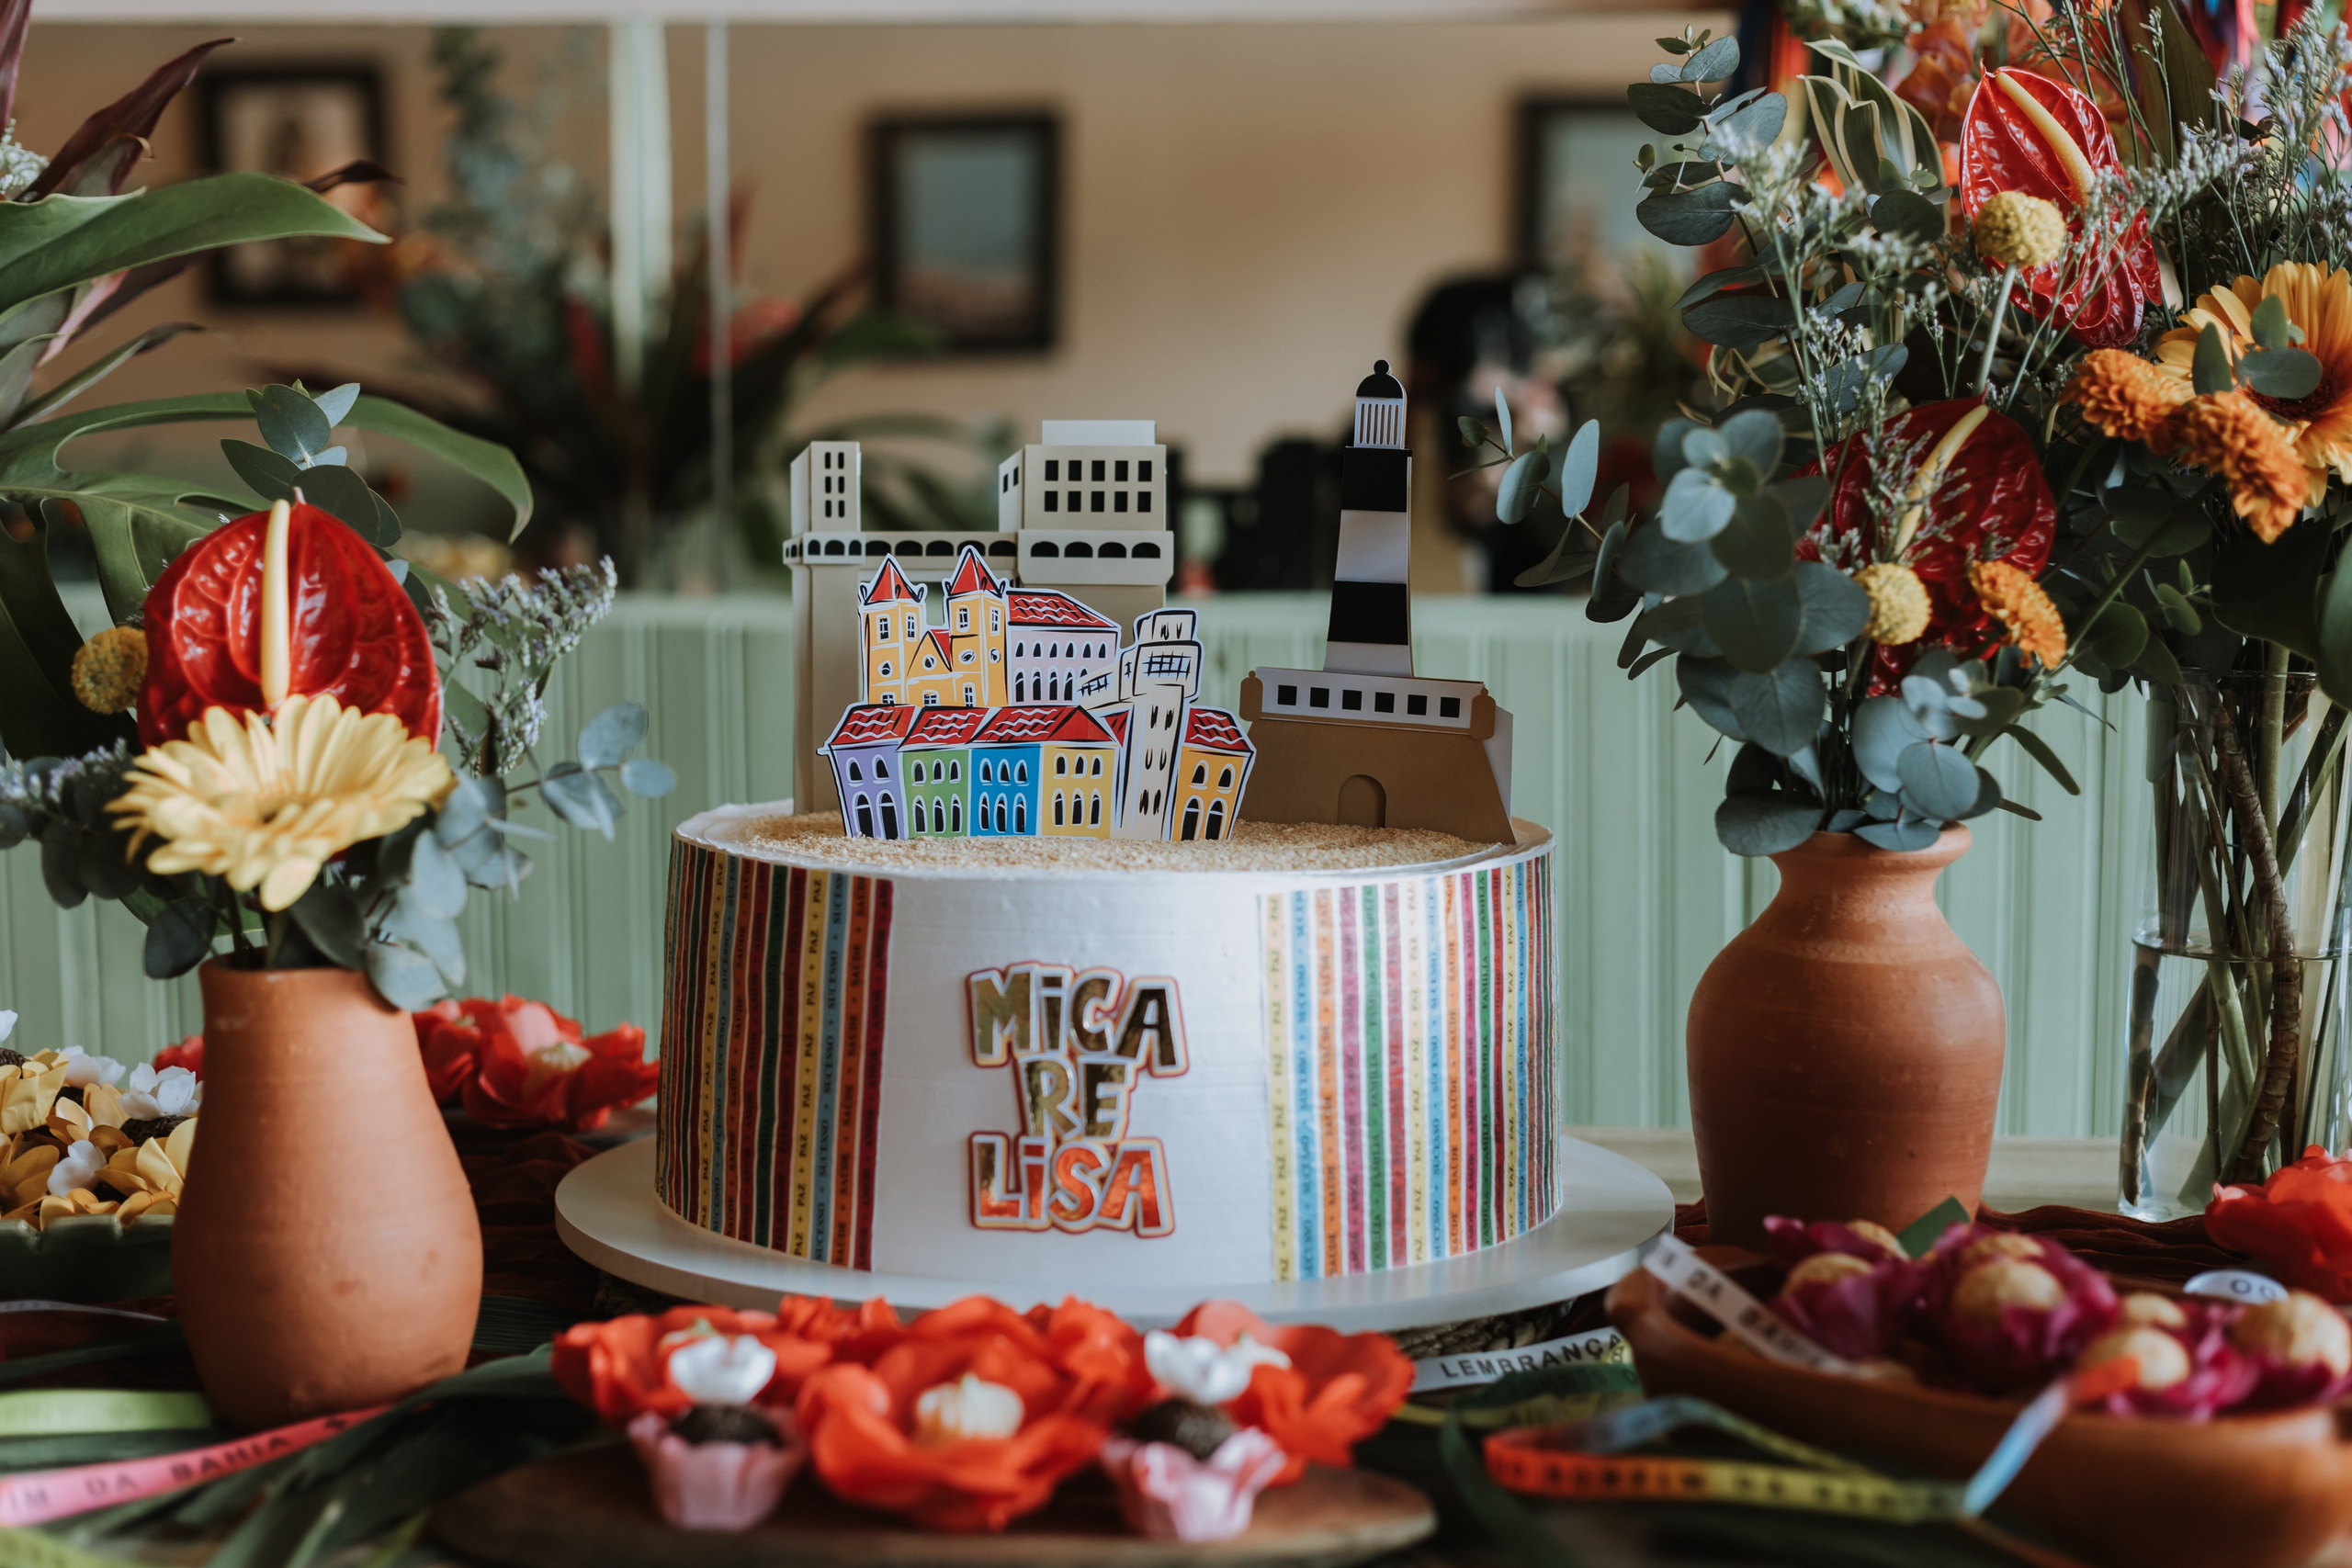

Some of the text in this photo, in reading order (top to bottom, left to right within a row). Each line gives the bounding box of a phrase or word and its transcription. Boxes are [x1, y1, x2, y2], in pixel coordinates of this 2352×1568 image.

[721, 931, 730, 991] SUCESSO
[1409, 936, 1418, 961] PAZ
[827, 950, 838, 1011] SUCESSO
[706, 1010, 714, 1037] PAZ
[717, 1015, 727, 1076] SUCESSO
[1411, 1038, 1419, 1063] PAZ
[793, 878, 821, 1258] PAZ PAZ PAZ PAZ PAZ PAZ PAZ PAZ
[823, 1035, 834, 1095] SUCESSO
[1270, 897, 1289, 1282] PAZ PAZ PAZ PAZ PAZ PAZ PAZ PAZ
[1020, 1057, 1130, 1140] RE
[819, 1118, 829, 1178] SUCESSO
[815, 1201, 825, 1261] SUCESSO
[1415, 1237, 1423, 1261] PAZ
[85, 1473, 137, 1497] DA
[169, 1436, 291, 1482] BAHIA
